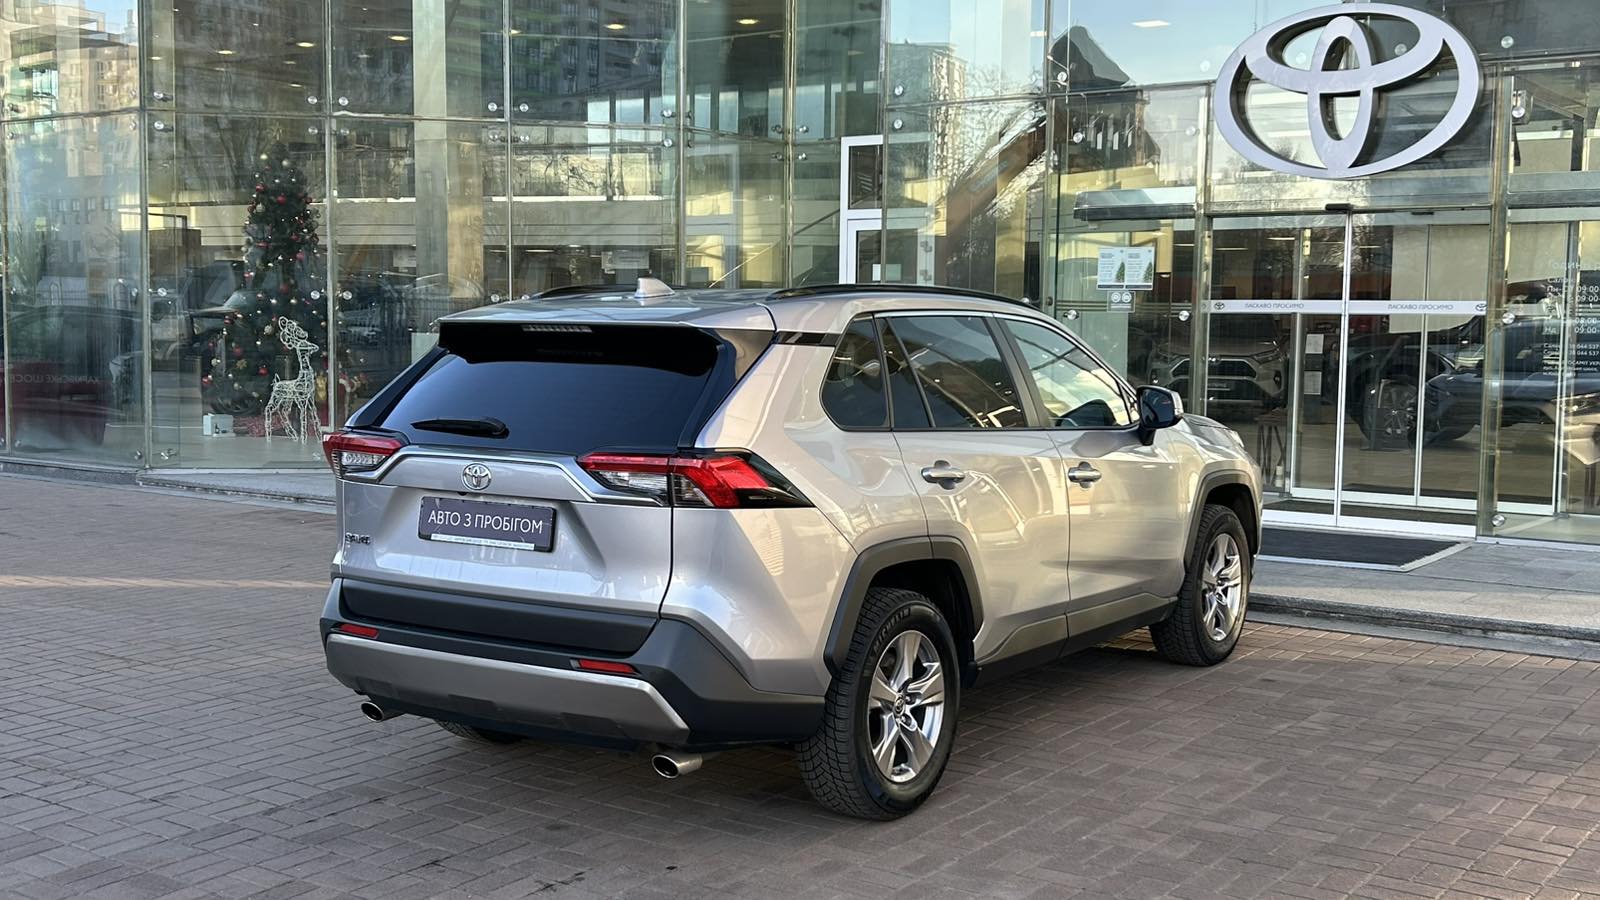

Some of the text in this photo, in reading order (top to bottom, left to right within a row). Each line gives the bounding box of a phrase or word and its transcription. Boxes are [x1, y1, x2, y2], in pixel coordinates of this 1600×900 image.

[428, 510, 543, 534] АВТО З ПРОБІГОМ
